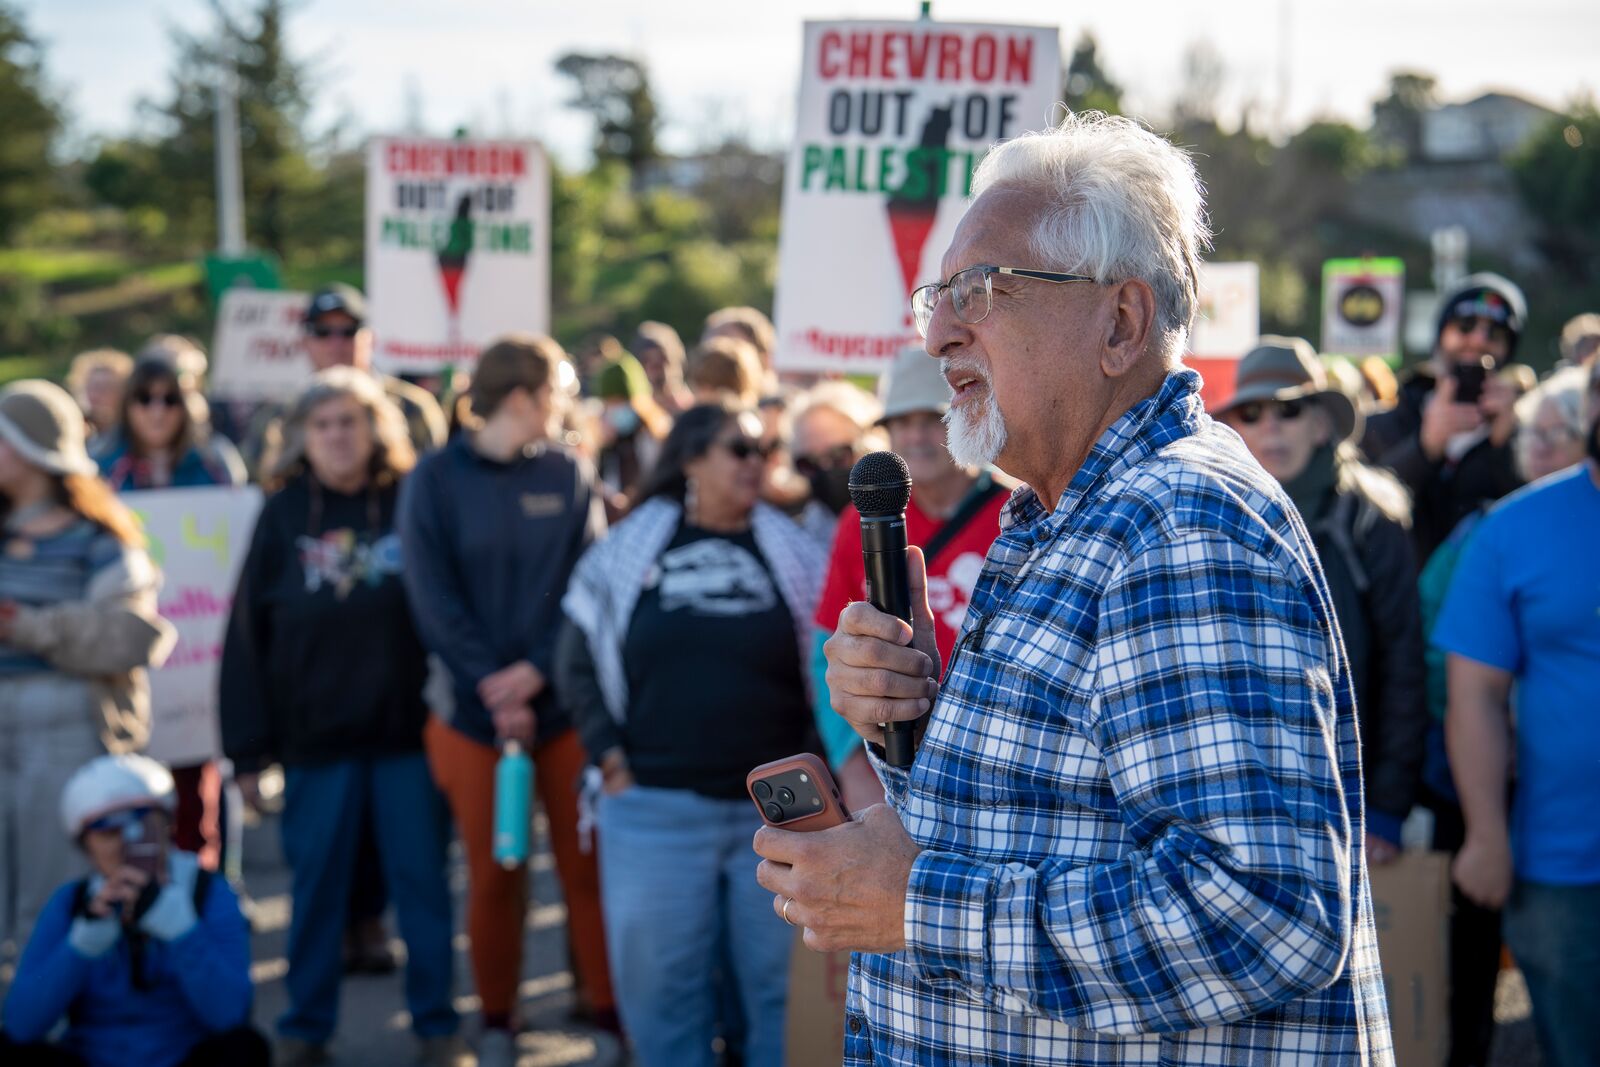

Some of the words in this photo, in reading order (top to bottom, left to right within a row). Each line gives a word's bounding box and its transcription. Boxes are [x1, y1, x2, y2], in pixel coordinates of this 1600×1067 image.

[817, 30, 1034, 84] CHEVRON
[828, 89, 914, 137] OUT
[963, 94, 1018, 138] OF
[801, 146, 976, 197] PALESTI
